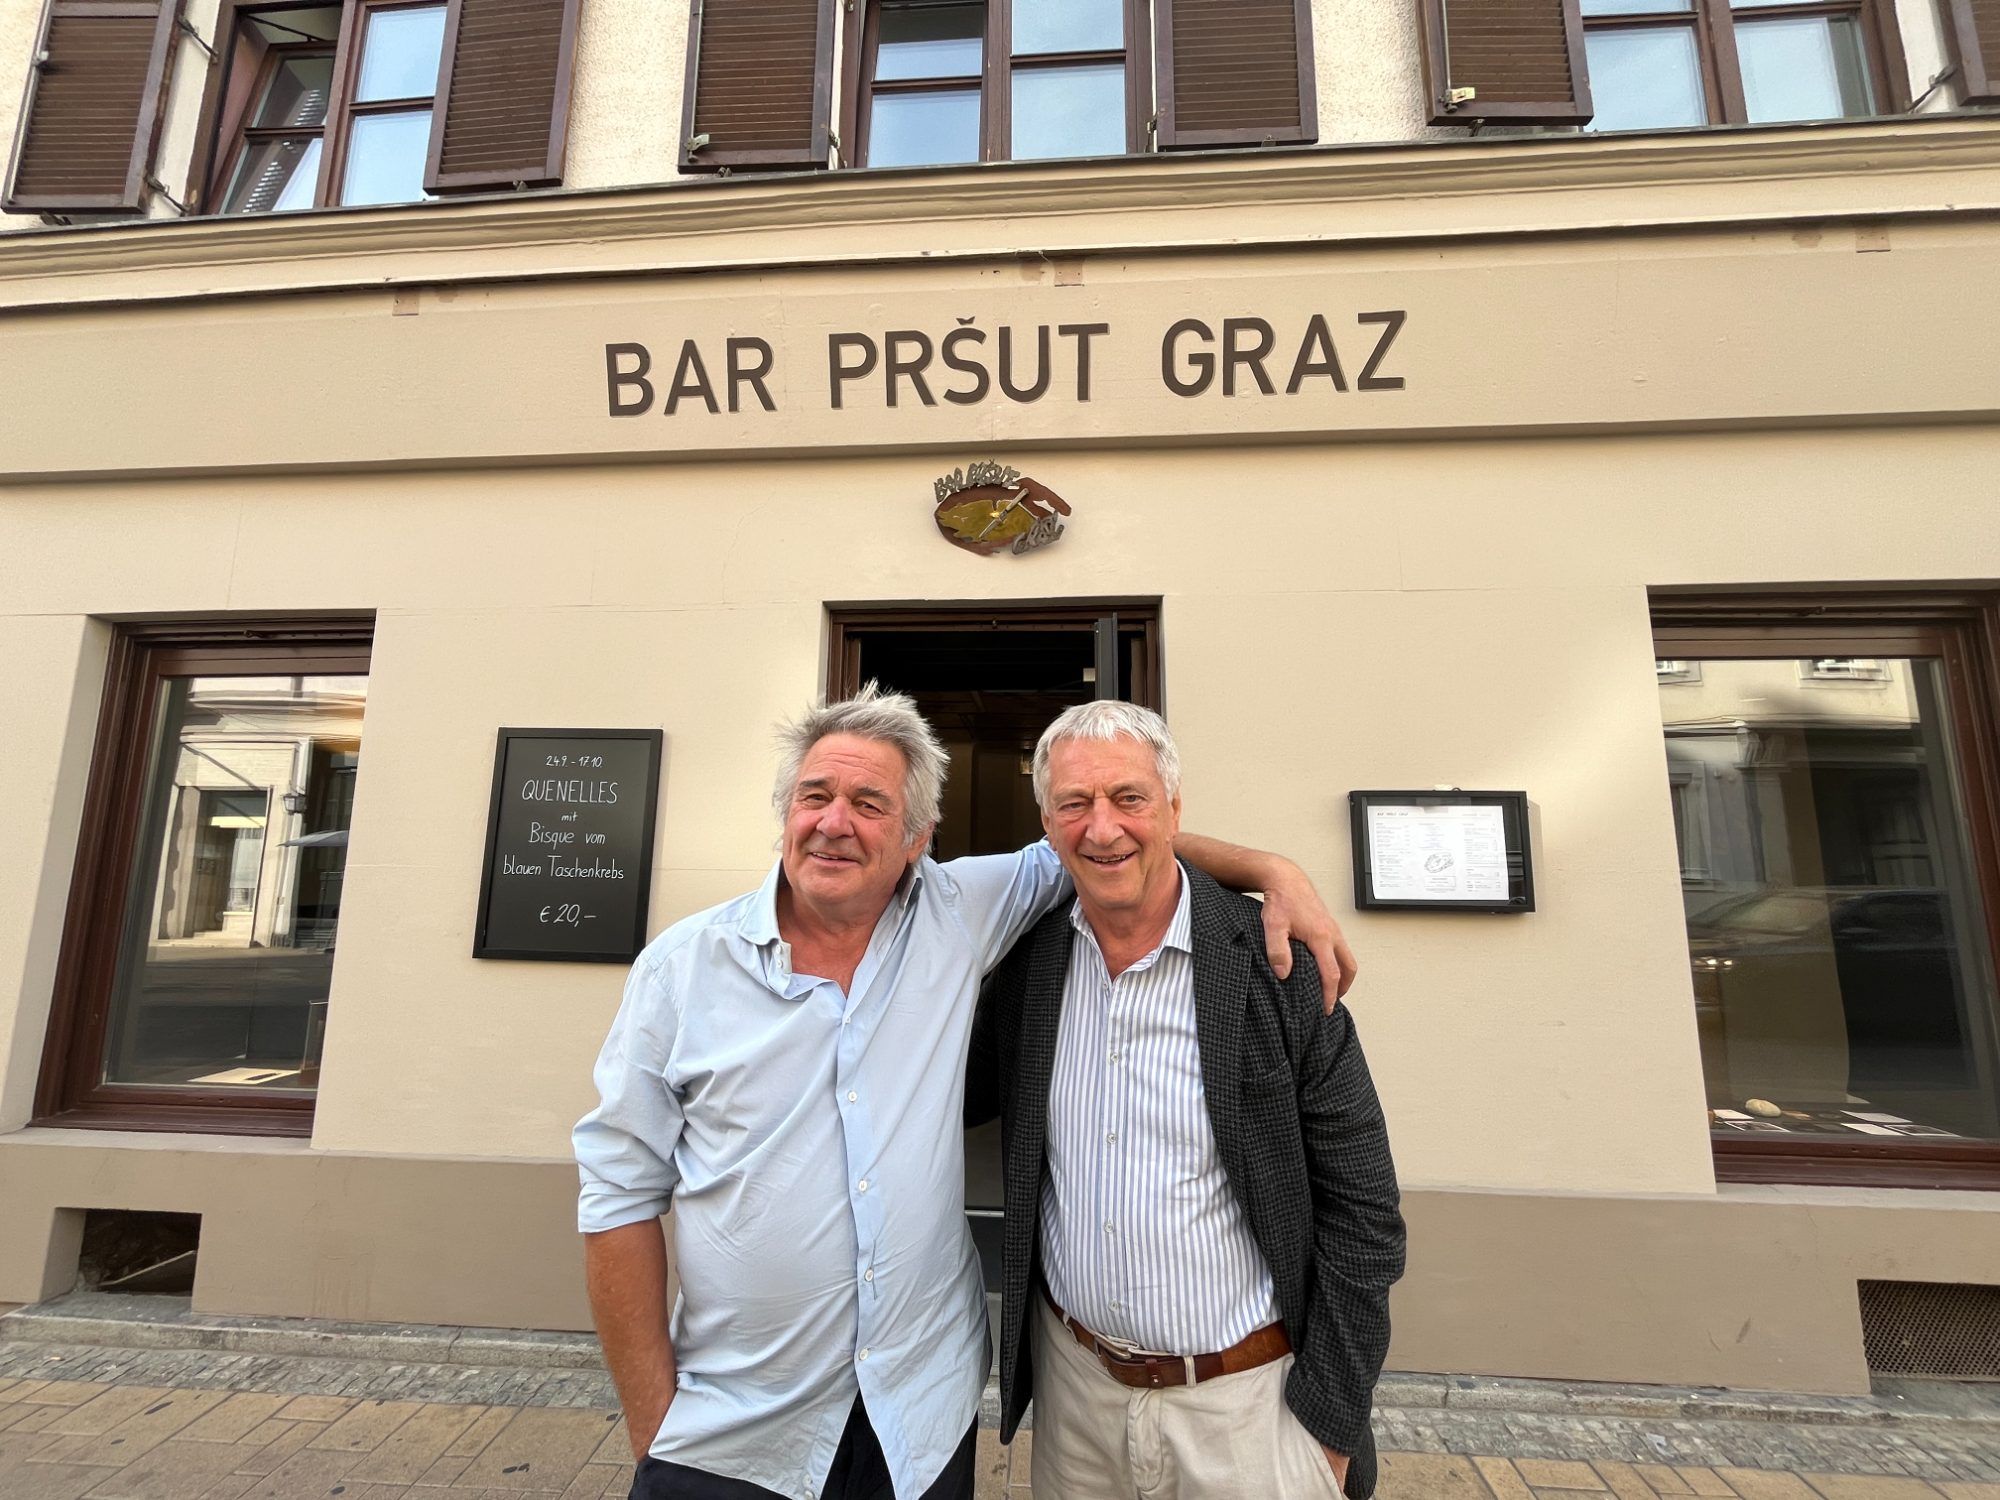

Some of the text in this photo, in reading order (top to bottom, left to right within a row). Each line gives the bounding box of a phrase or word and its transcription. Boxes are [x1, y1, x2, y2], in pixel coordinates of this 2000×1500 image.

[606, 310, 1407, 417] BAR PRŠUT GRAZ
[934, 467, 963, 503] BAR
[522, 779, 619, 804] QUENELLES
[561, 812, 578, 822] mit
[528, 822, 606, 850] Bisque vom
[503, 854, 624, 879] blauen Taschenkrebs
